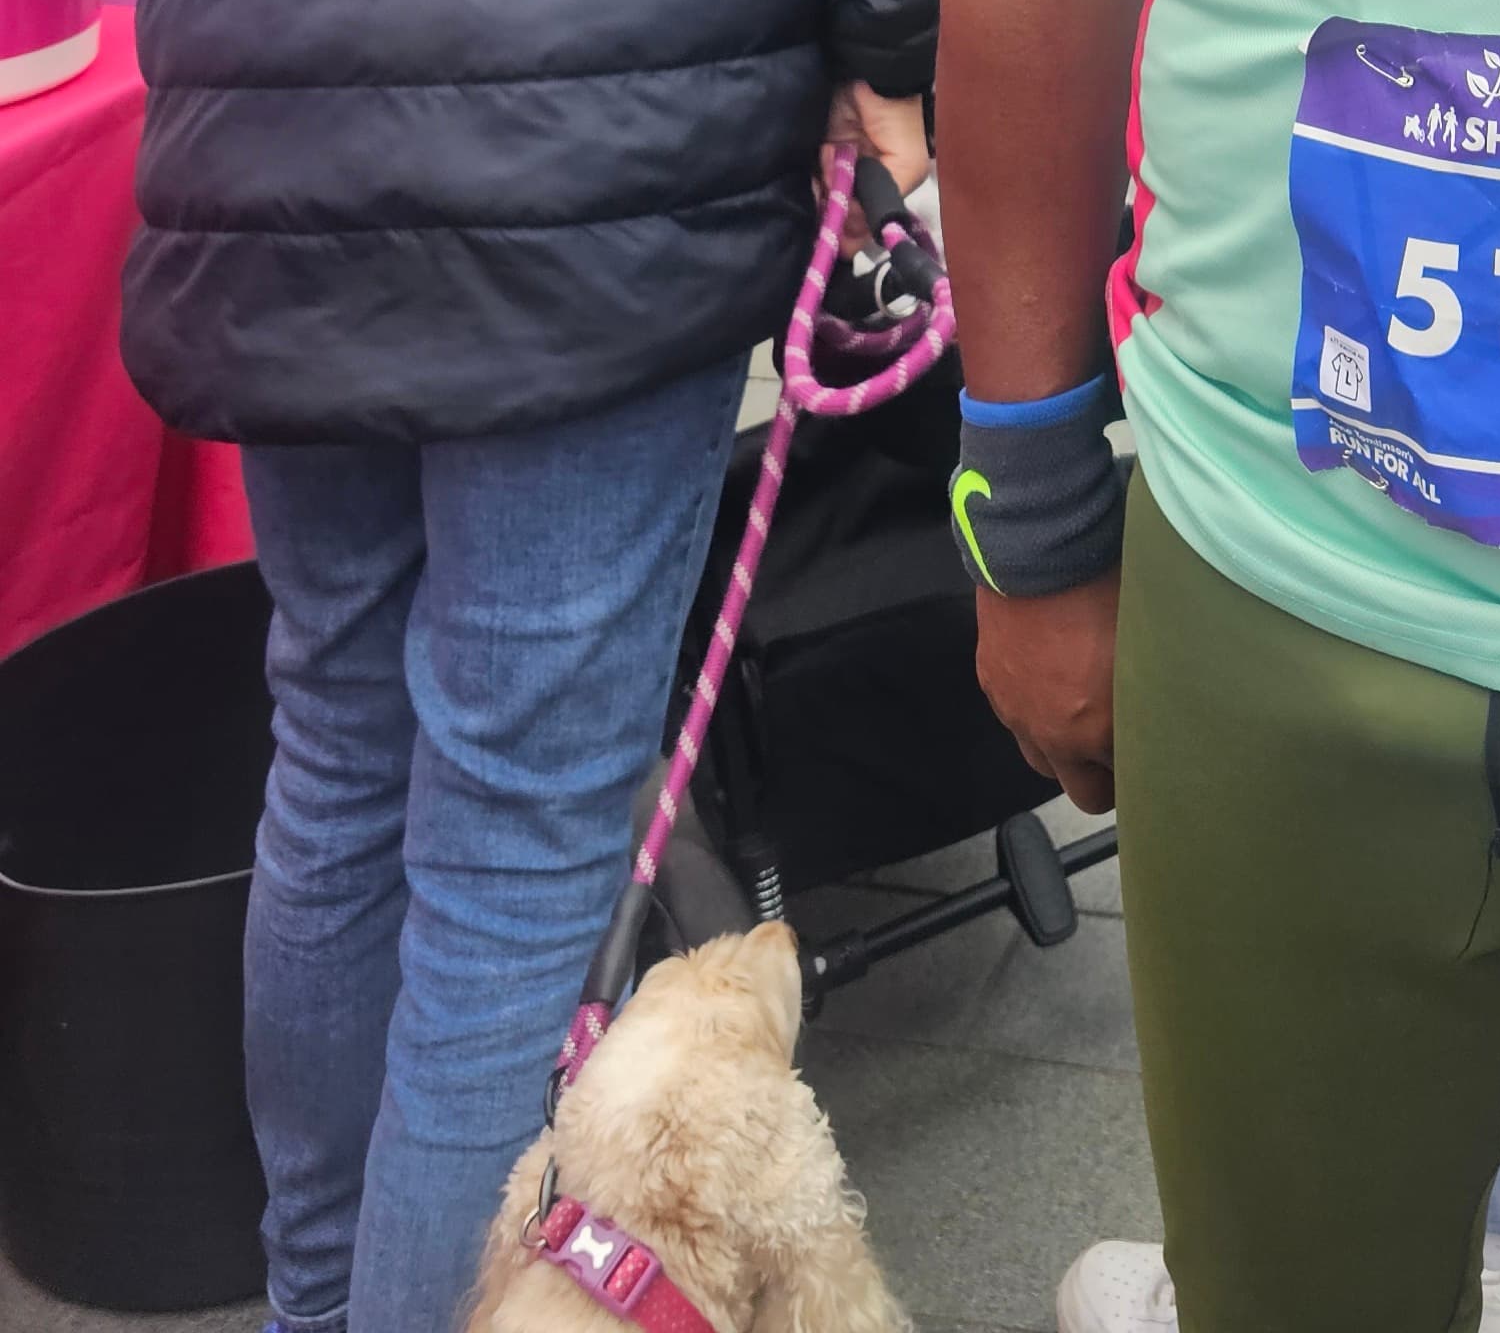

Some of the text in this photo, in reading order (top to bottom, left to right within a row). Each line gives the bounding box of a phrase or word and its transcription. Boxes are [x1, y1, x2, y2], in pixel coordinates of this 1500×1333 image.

[1329, 427, 1442, 505] RUN FOR ALL
